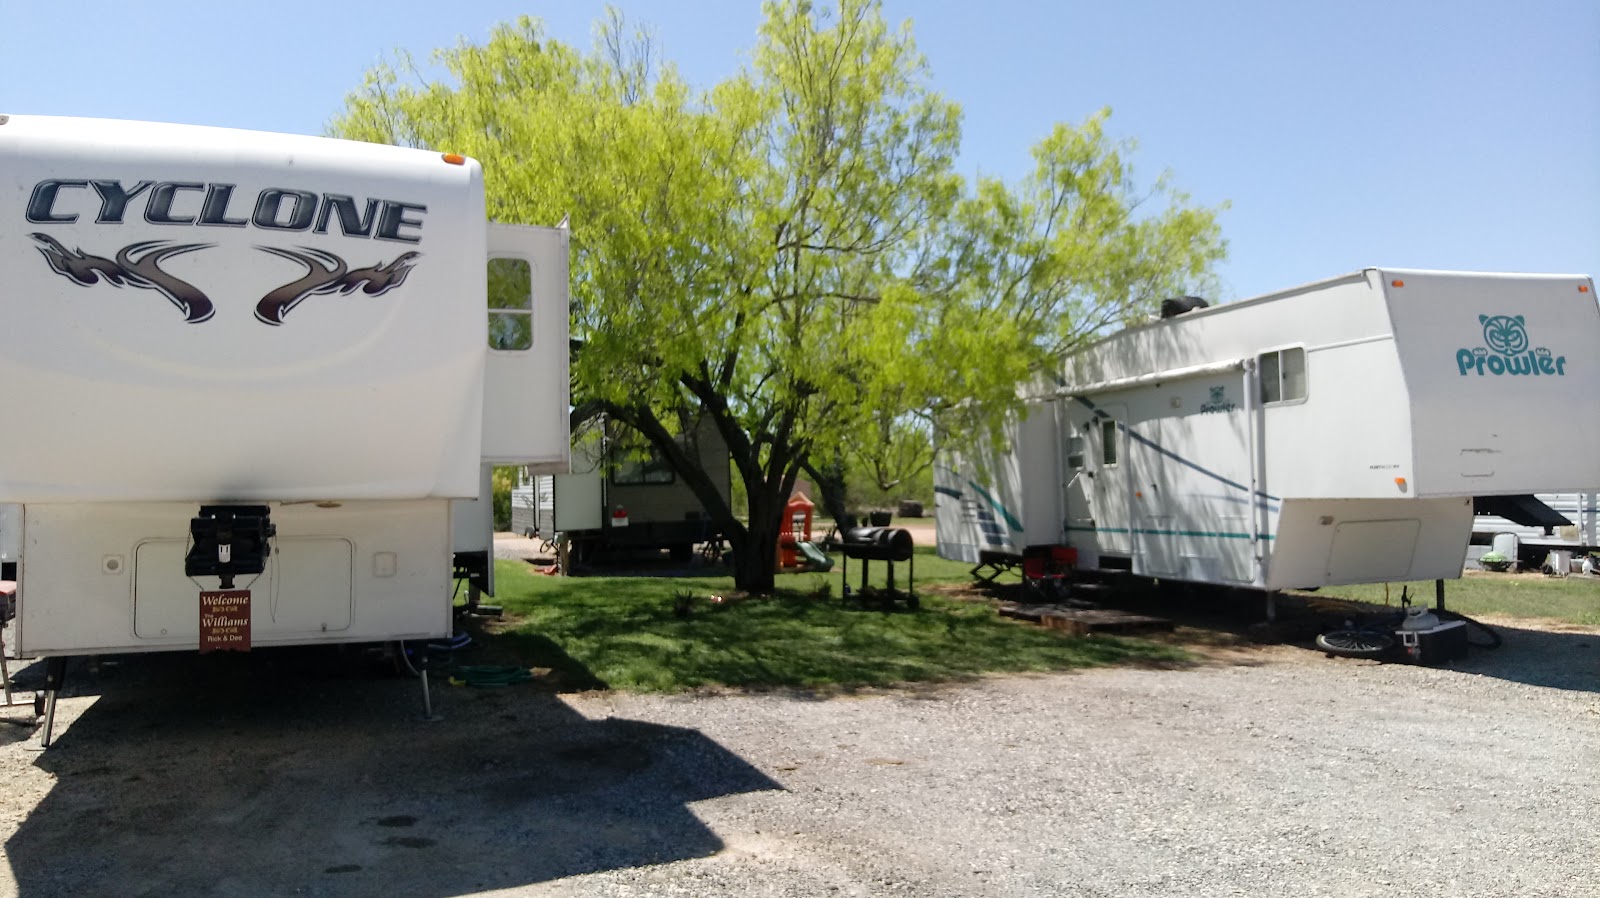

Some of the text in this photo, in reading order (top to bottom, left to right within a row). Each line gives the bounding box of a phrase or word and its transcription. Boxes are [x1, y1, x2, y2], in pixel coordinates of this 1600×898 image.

[25, 178, 428, 244] CYCLONE
[1456, 348, 1567, 376] Prowler
[1200, 403, 1236, 415] Prowler
[202, 594, 248, 606] Welcome
[202, 616, 248, 628] Williams
[207, 635, 222, 643] Rick
